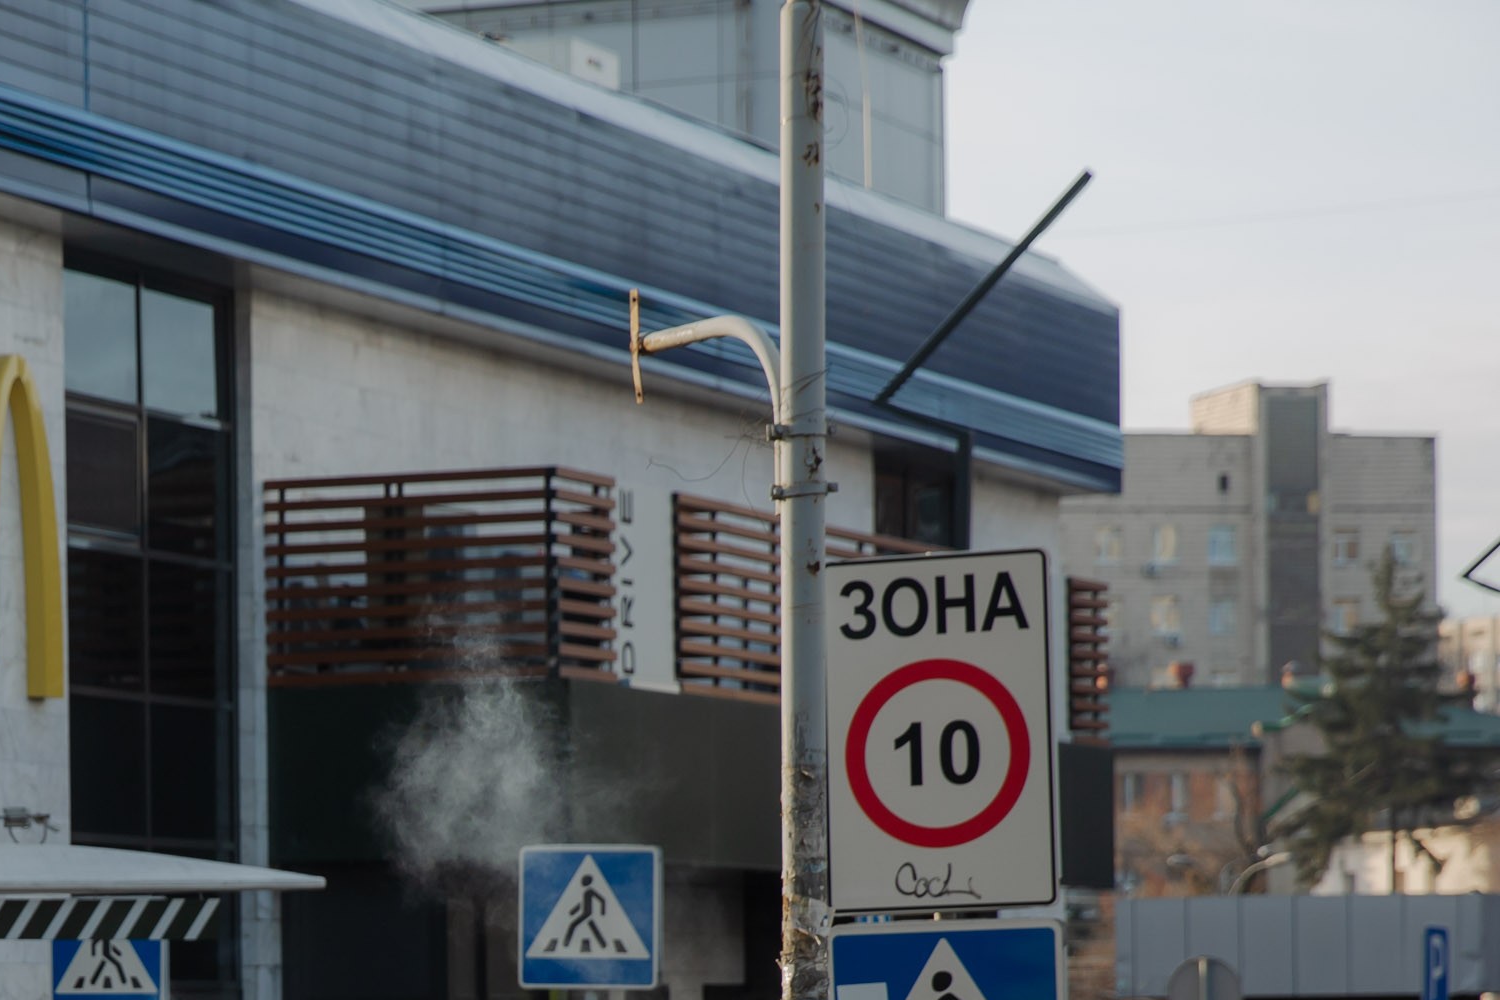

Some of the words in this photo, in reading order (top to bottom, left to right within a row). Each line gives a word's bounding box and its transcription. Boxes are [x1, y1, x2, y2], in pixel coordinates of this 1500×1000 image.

[619, 490, 635, 674] DRIVE
[839, 571, 1030, 640] ЗОНА
[894, 719, 980, 787] 10
